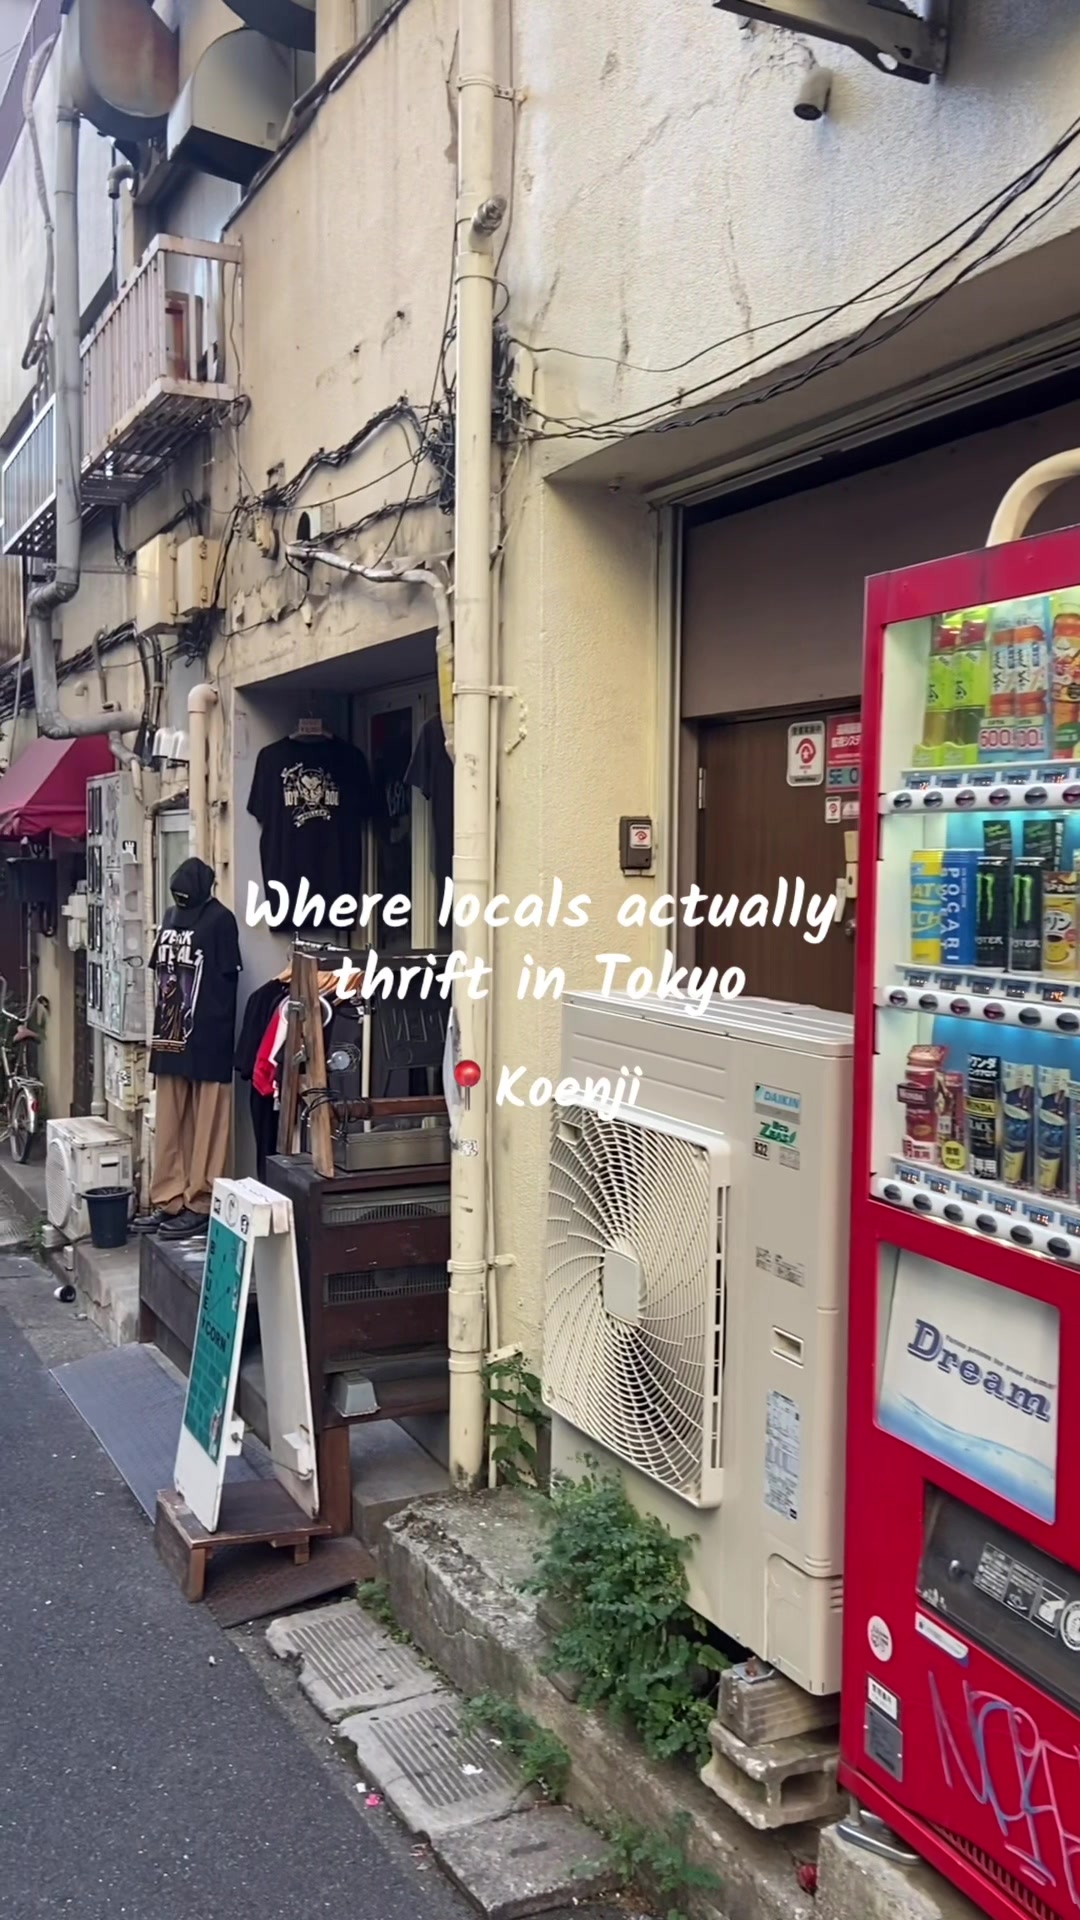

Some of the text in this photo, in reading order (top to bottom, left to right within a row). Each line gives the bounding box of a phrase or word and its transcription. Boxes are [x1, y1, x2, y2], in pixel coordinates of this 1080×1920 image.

[946, 867, 960, 960] POCARI
[764, 1091, 799, 1108] DAIKIN
[907, 1318, 1051, 1423] Dream
